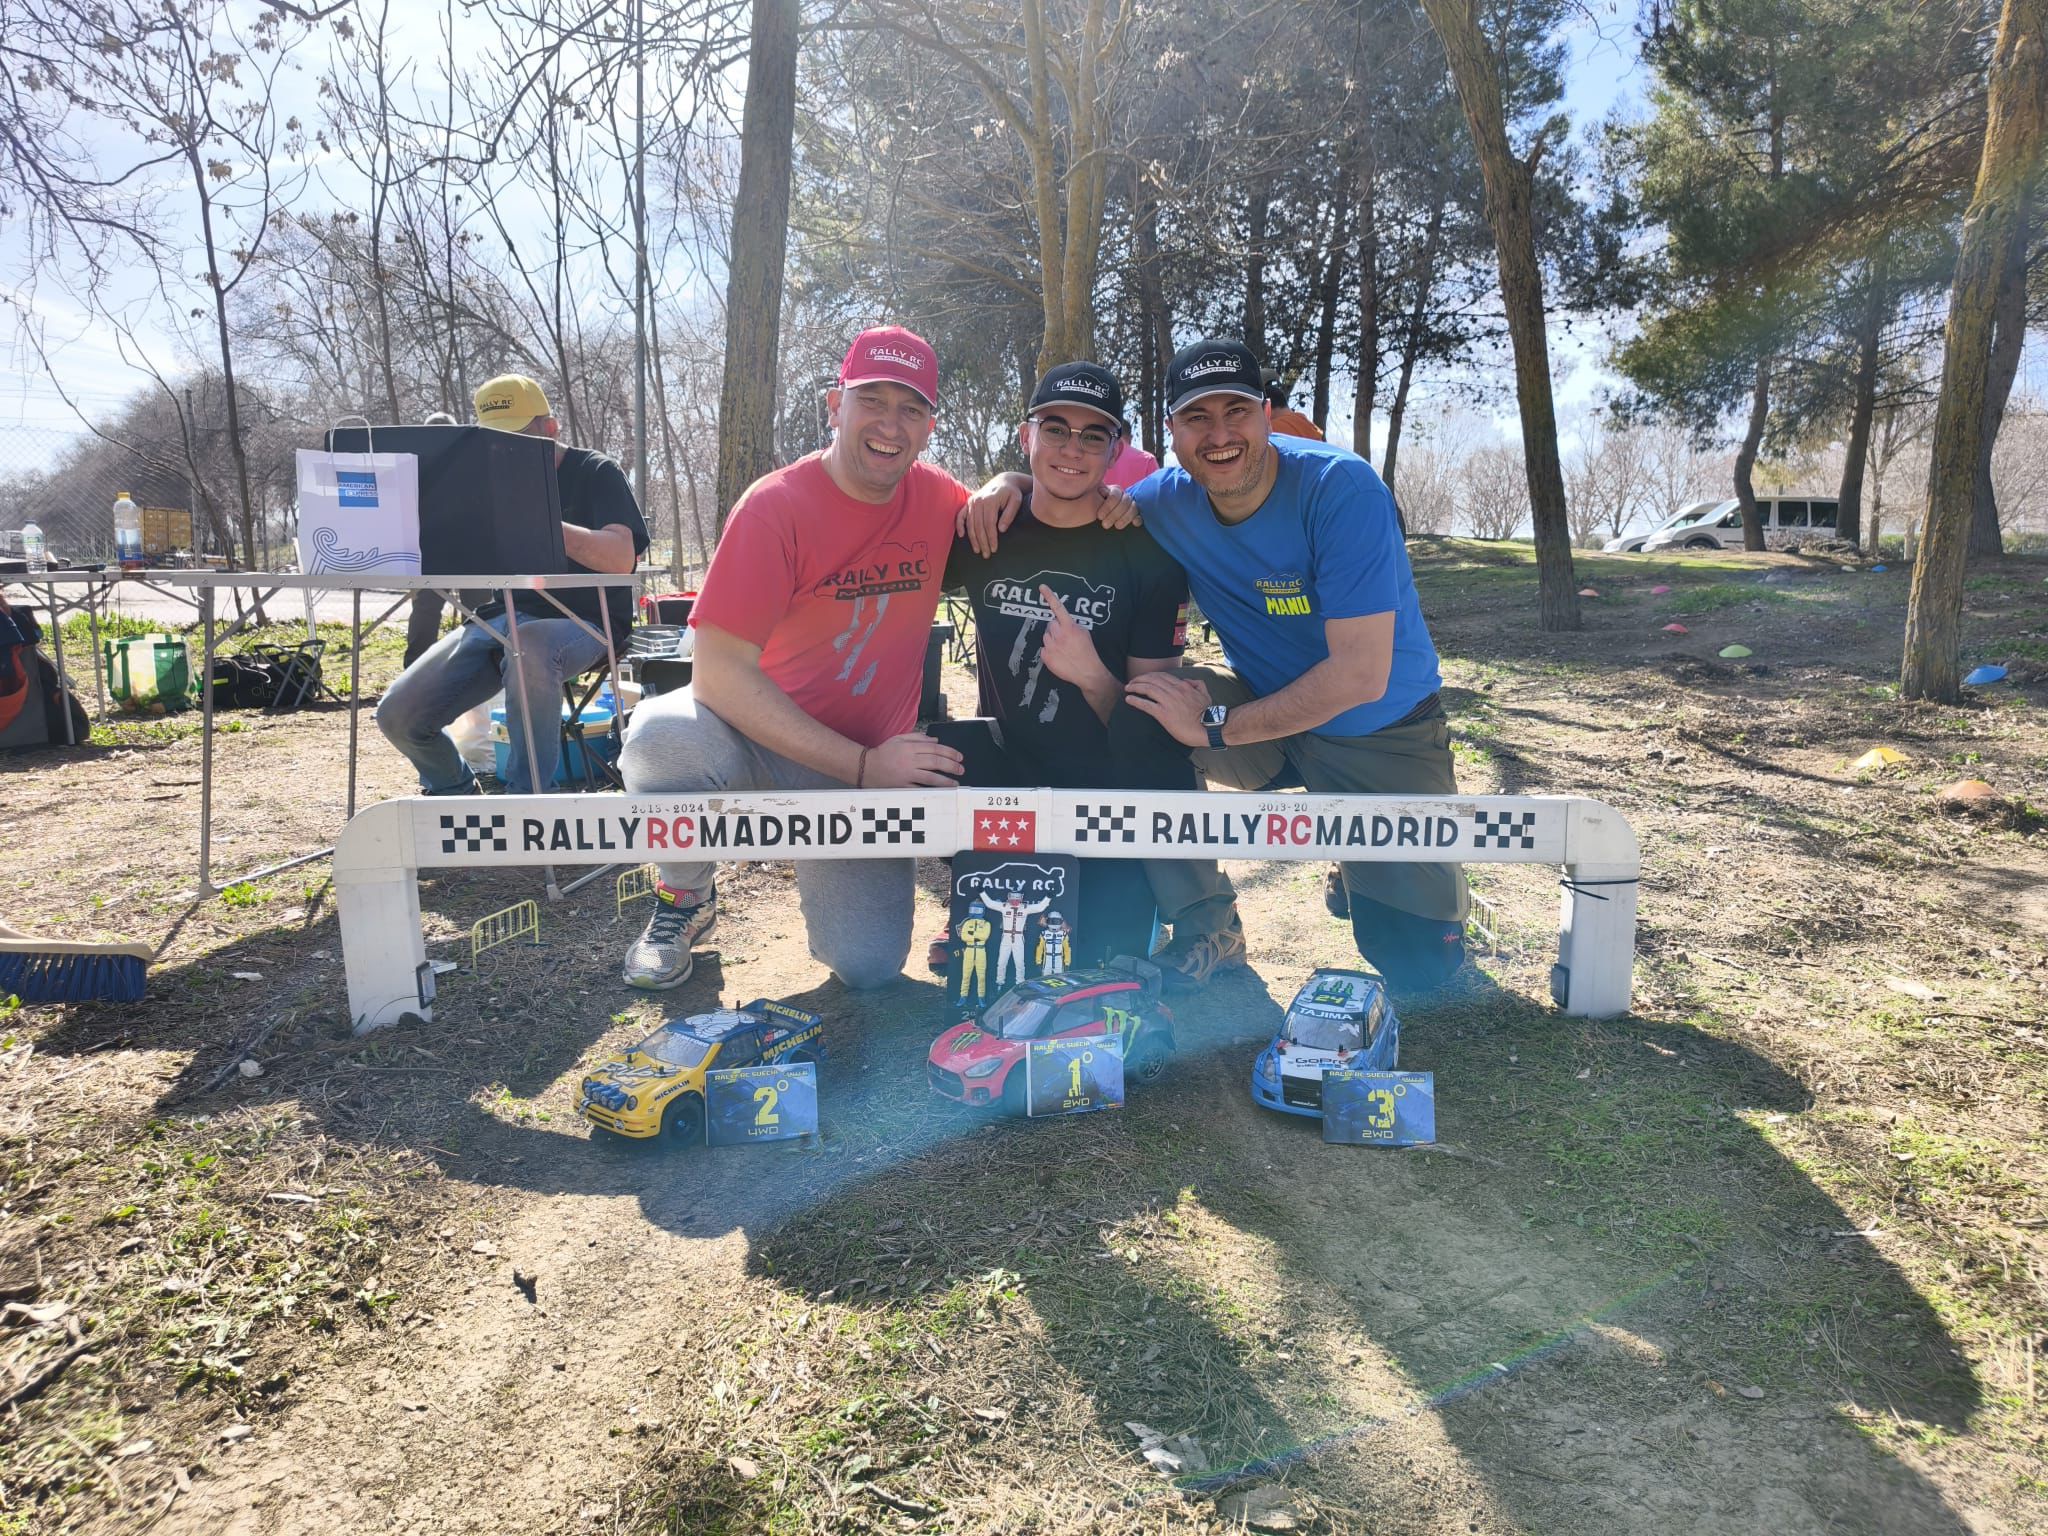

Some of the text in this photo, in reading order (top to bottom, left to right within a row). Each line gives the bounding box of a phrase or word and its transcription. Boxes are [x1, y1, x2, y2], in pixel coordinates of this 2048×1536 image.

[870, 348, 907, 358] RALLY
[910, 355, 923, 367] RC
[1185, 359, 1221, 376] RALLY
[1225, 360, 1240, 368] RC
[1056, 379, 1092, 388] RALLY
[1094, 385, 1108, 396] RC
[898, 559, 928, 577] RC
[1256, 578, 1303, 589] RALLY RC
[1075, 597, 1107, 618] RC
[1264, 594, 1312, 616] MANU
[987, 796, 1020, 806] 2024
[970, 877, 1055, 892] RALLY RC
[764, 1002, 812, 1022] MICHELIN
[1299, 1007, 1353, 1020] TAJIMA
[762, 1023, 823, 1061] MICHELIN
[654, 1079, 690, 1102] MICHELIN
[1062, 1097, 1090, 1108] 2WD
[747, 1126, 779, 1137] 4WD
[1362, 1129, 1394, 1139] 2WD
